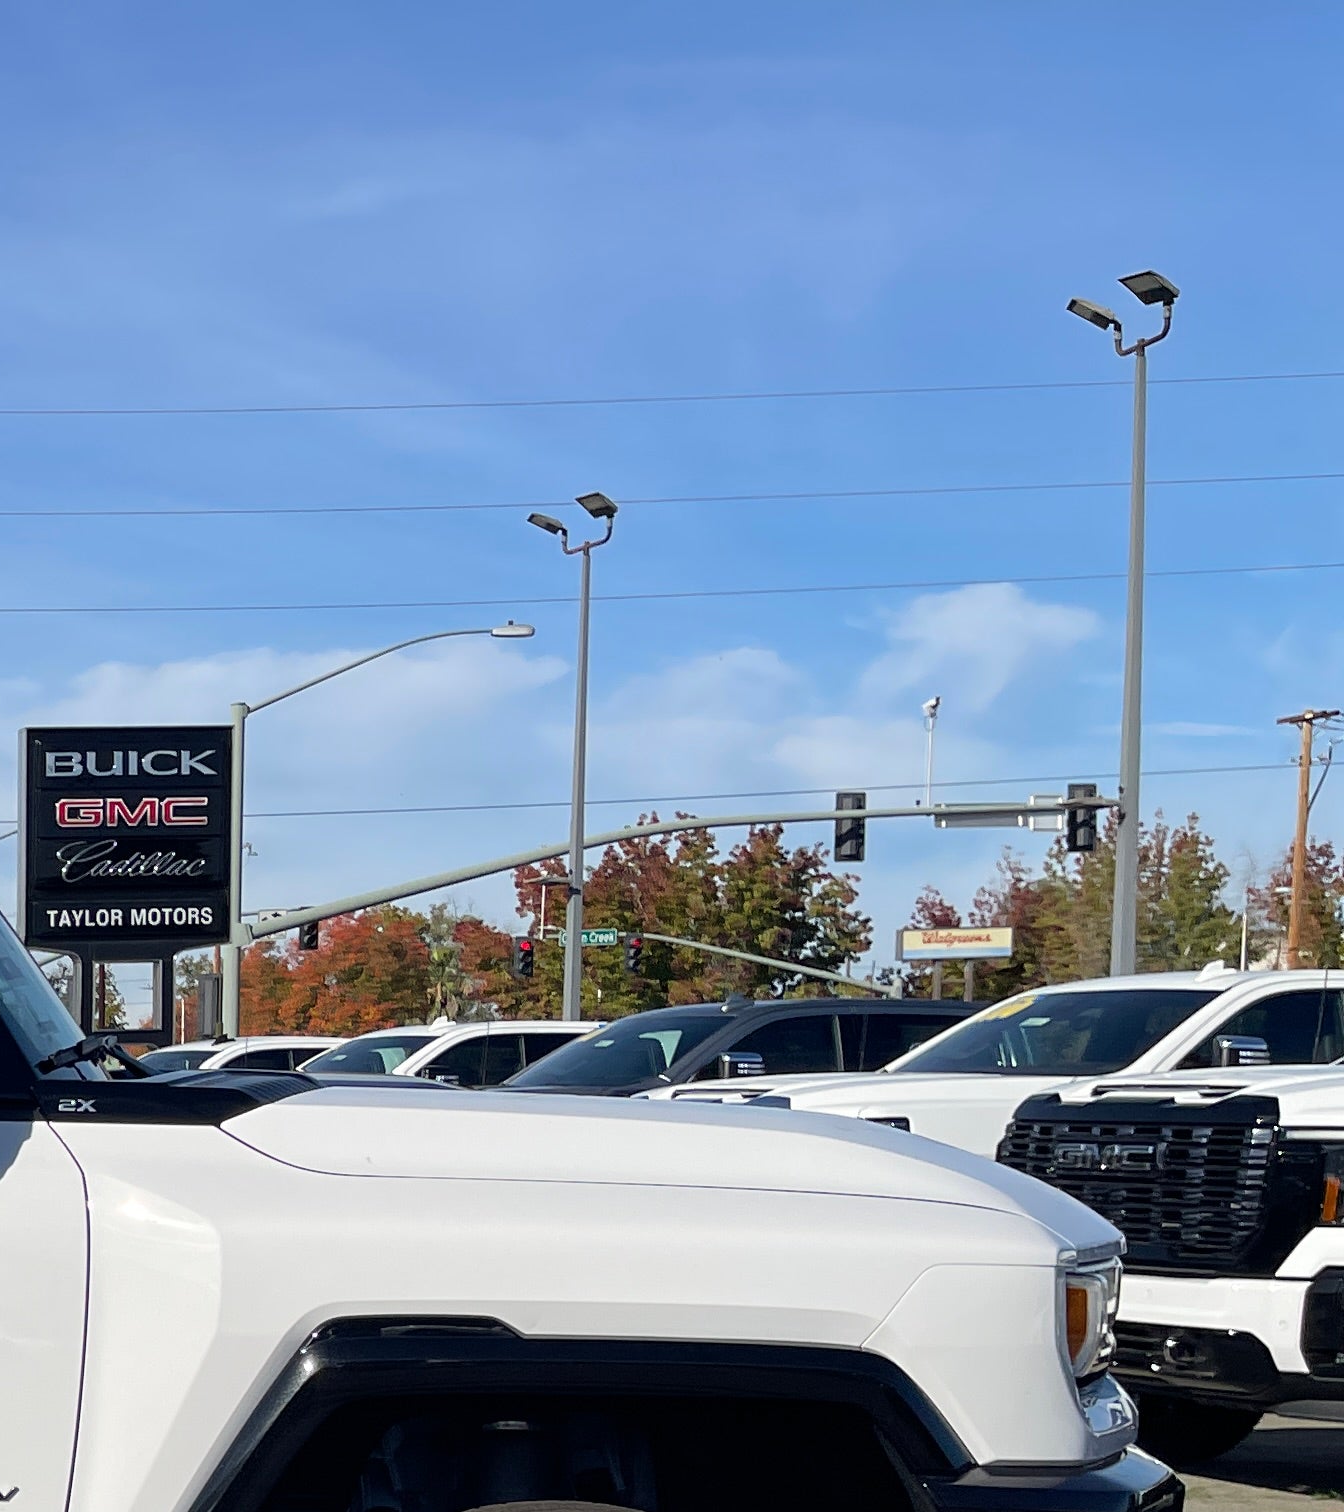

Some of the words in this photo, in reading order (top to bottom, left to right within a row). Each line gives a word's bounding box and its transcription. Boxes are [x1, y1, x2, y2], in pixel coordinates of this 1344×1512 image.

[45, 750, 218, 777] BUICK
[55, 797, 208, 827] GMC
[56, 839, 206, 883] Cadillac
[46, 908, 123, 928] TAYLOR
[130, 907, 213, 926] MOTORS
[58, 1098, 97, 1112] 2X
